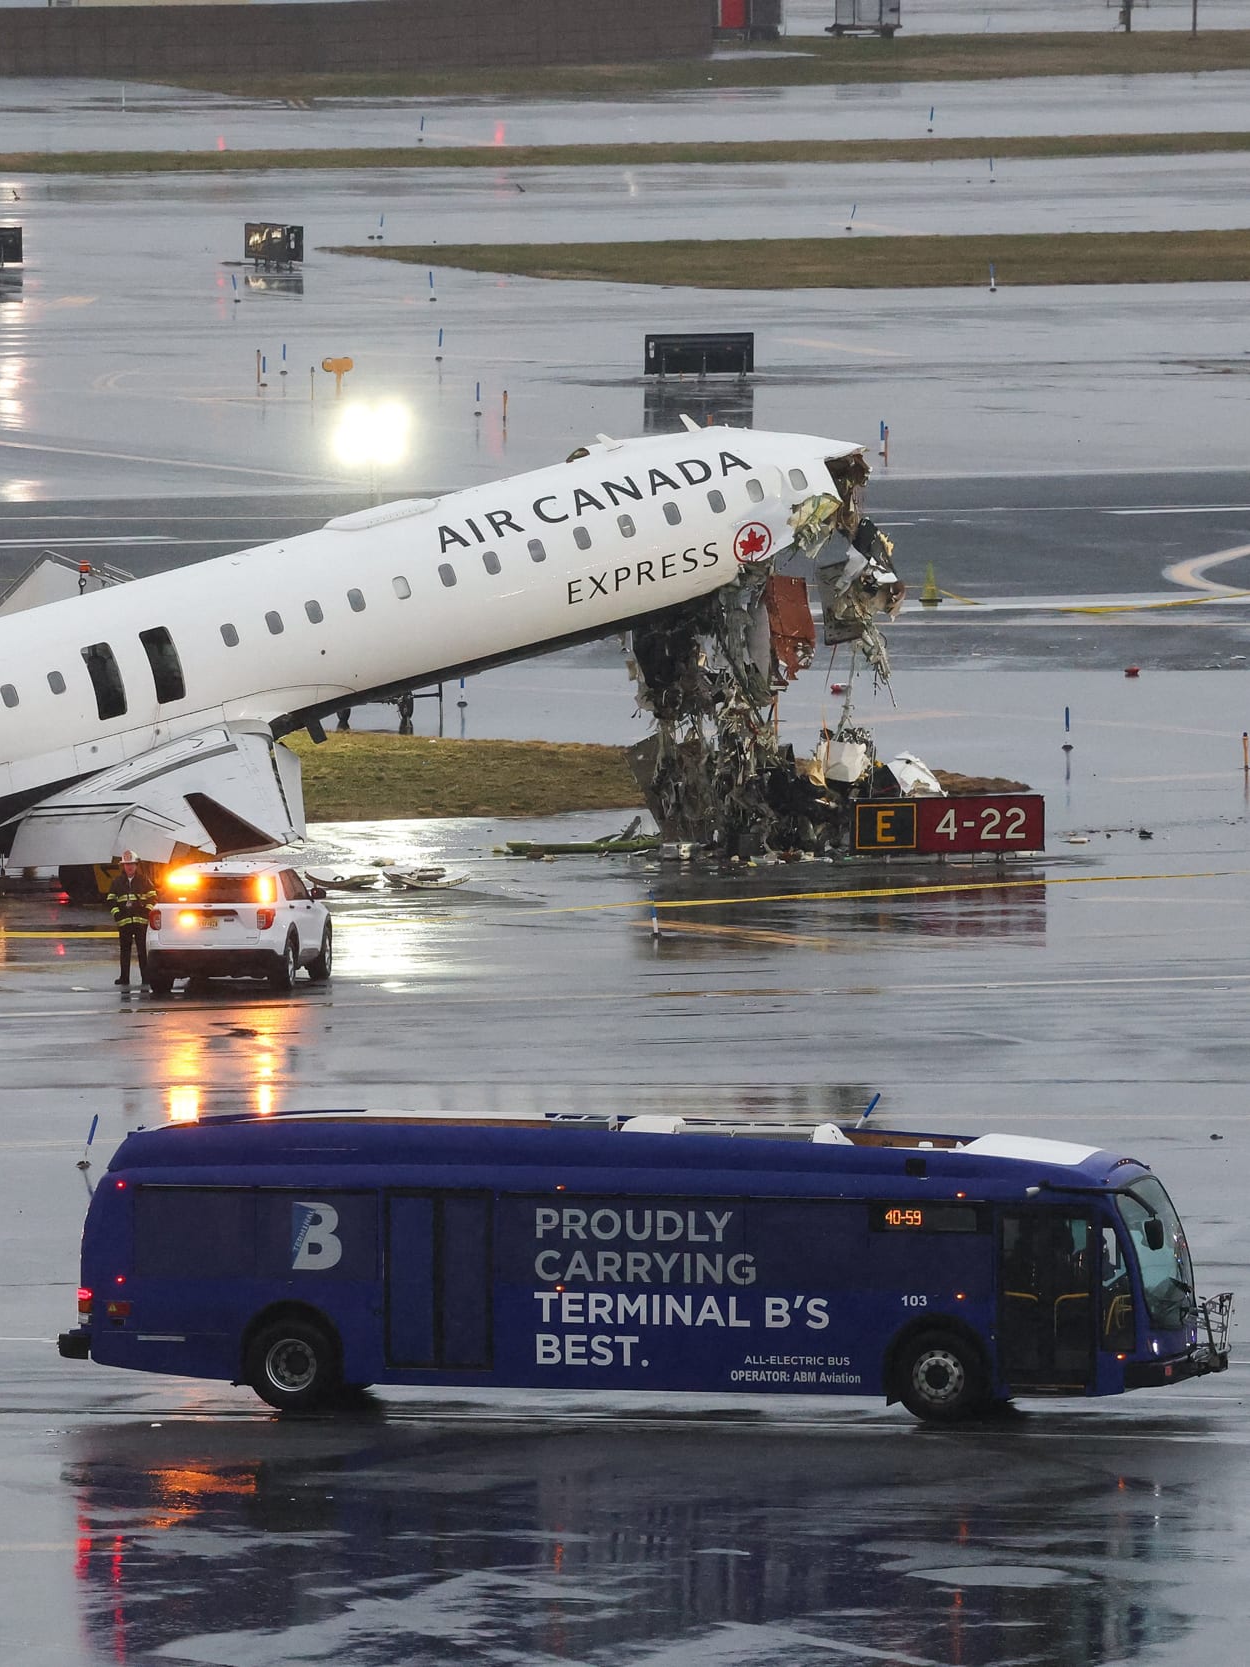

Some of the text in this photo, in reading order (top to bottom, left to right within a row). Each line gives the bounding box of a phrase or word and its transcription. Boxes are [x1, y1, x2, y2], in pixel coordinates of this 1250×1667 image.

[438, 451, 753, 553] AIR CANADA
[567, 542, 719, 605] EXPRESS
[876, 807, 1026, 843] E 4-22
[535, 1207, 733, 1242] PROUDLY
[884, 1209, 922, 1226] 40-59
[292, 1201, 342, 1270] B
[534, 1250, 756, 1286] CARRYING
[534, 1291, 830, 1330] TERMINAL B'S
[901, 1295, 928, 1306] 103
[535, 1333, 650, 1368] BEST.
[744, 1355, 851, 1366] ALL-ELECTRIC BUS
[730, 1370, 862, 1384] OPERATOR: ABM Aviation
